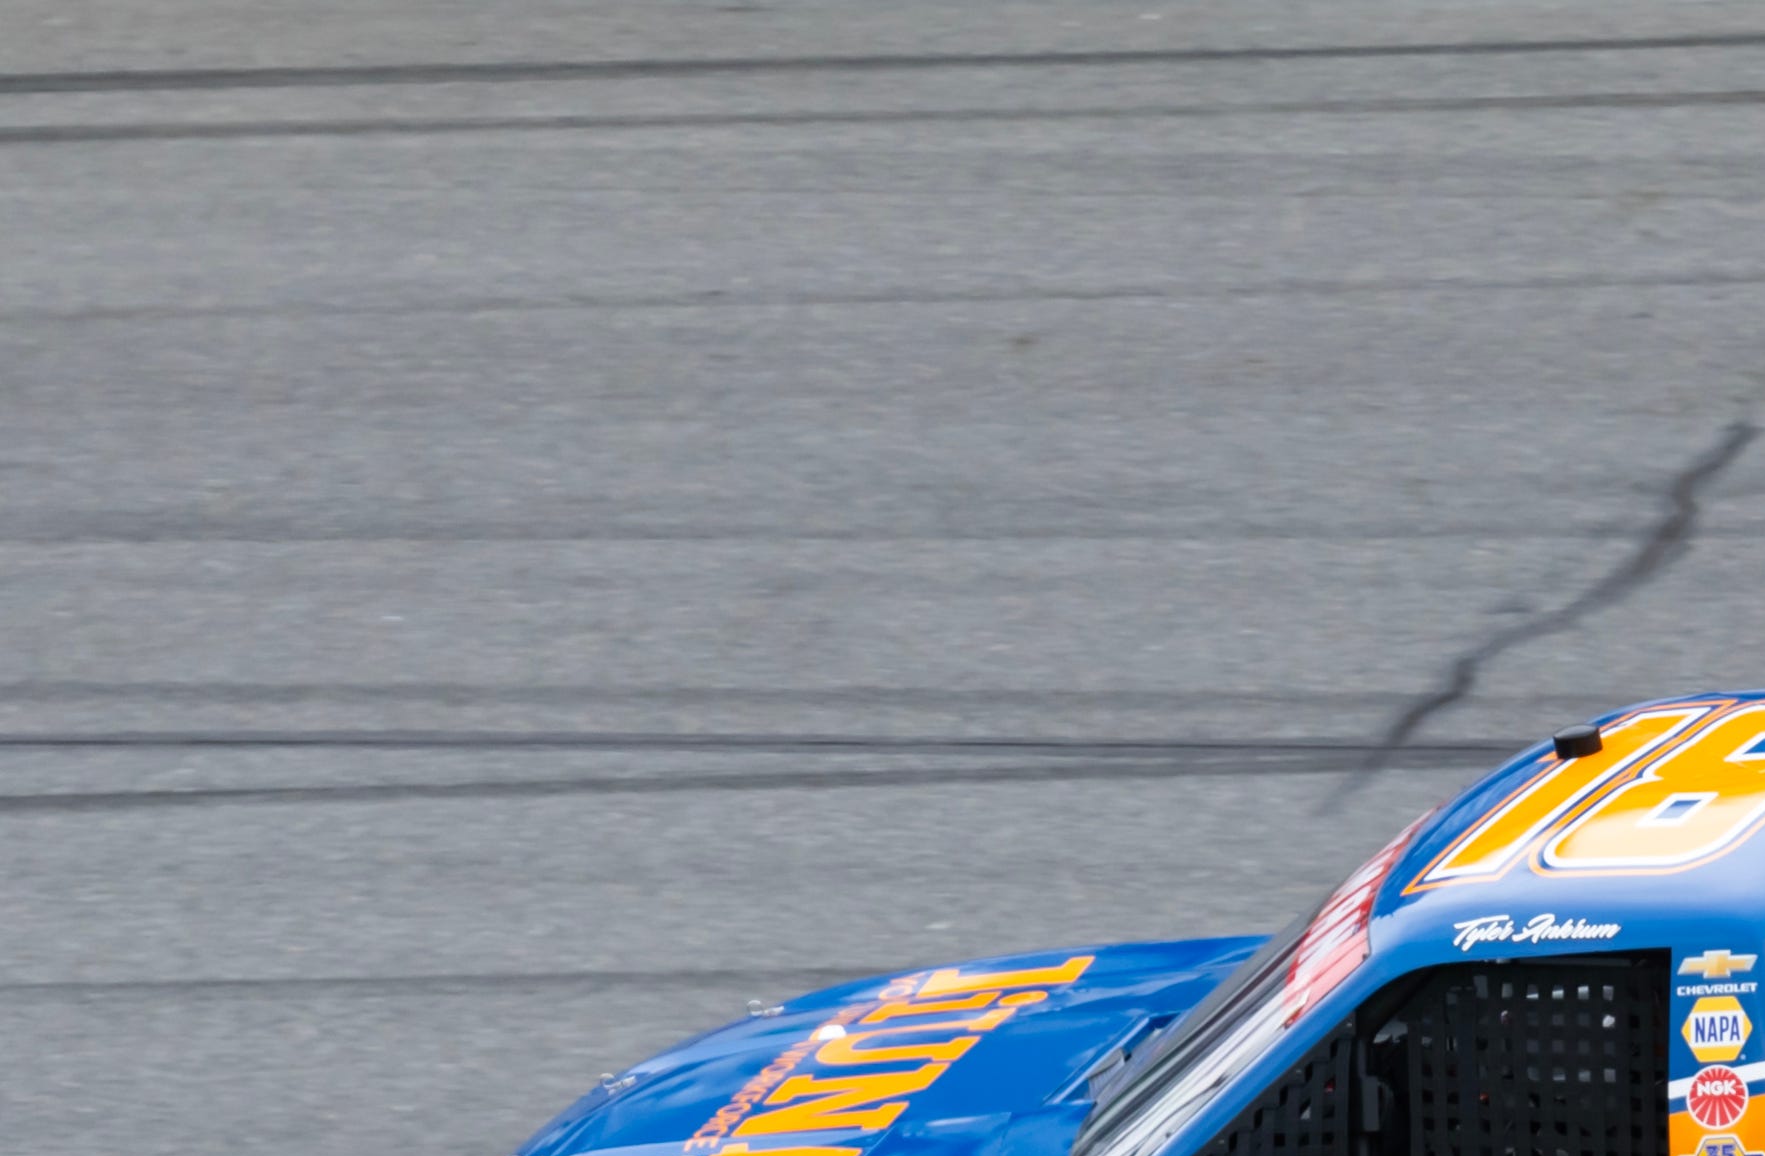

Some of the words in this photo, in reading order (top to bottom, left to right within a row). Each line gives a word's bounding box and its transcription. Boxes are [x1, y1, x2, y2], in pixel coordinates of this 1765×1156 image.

[1453, 914, 1514, 952] Tyler
[1676, 981, 1758, 997] CHEVROLET
[1694, 1014, 1741, 1043] NAPA
[1696, 1079, 1737, 1097] NGK
